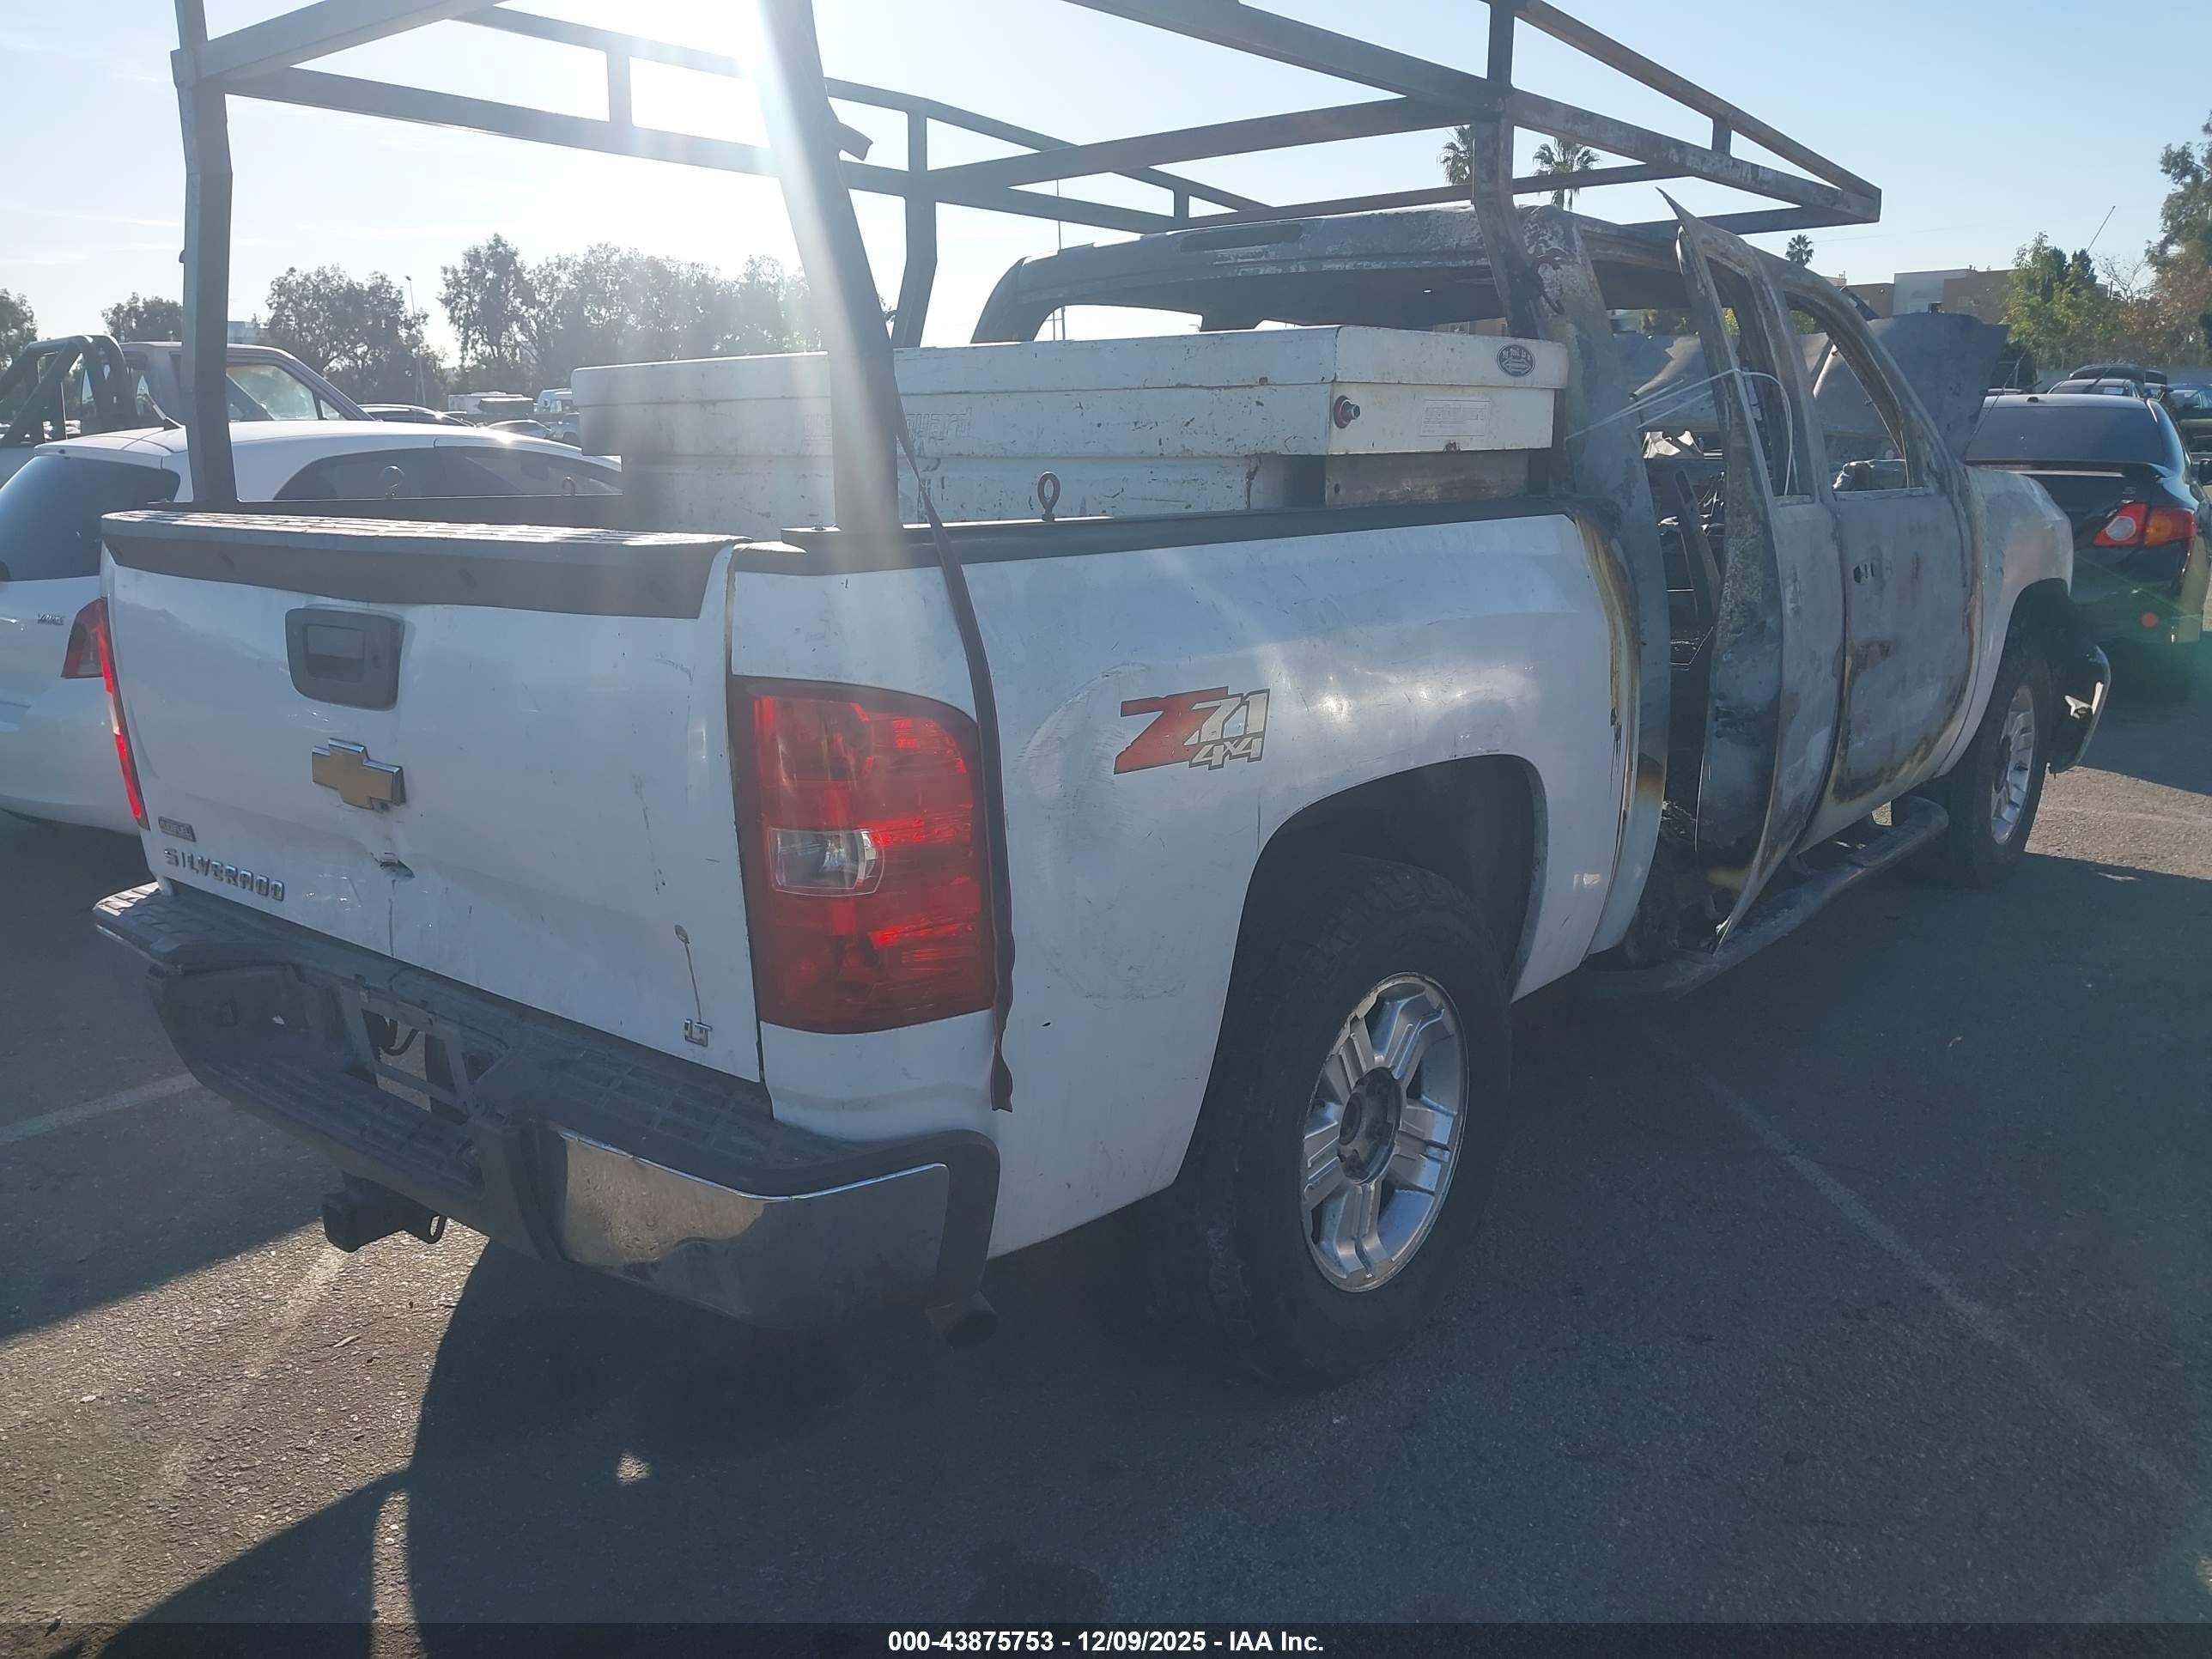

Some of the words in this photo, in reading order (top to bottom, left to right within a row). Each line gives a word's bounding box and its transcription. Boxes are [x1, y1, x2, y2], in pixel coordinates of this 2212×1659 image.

[1114, 686, 1270, 775] Z71
[164, 848, 286, 902] SILVERADO
[684, 1018, 714, 1048] LT
